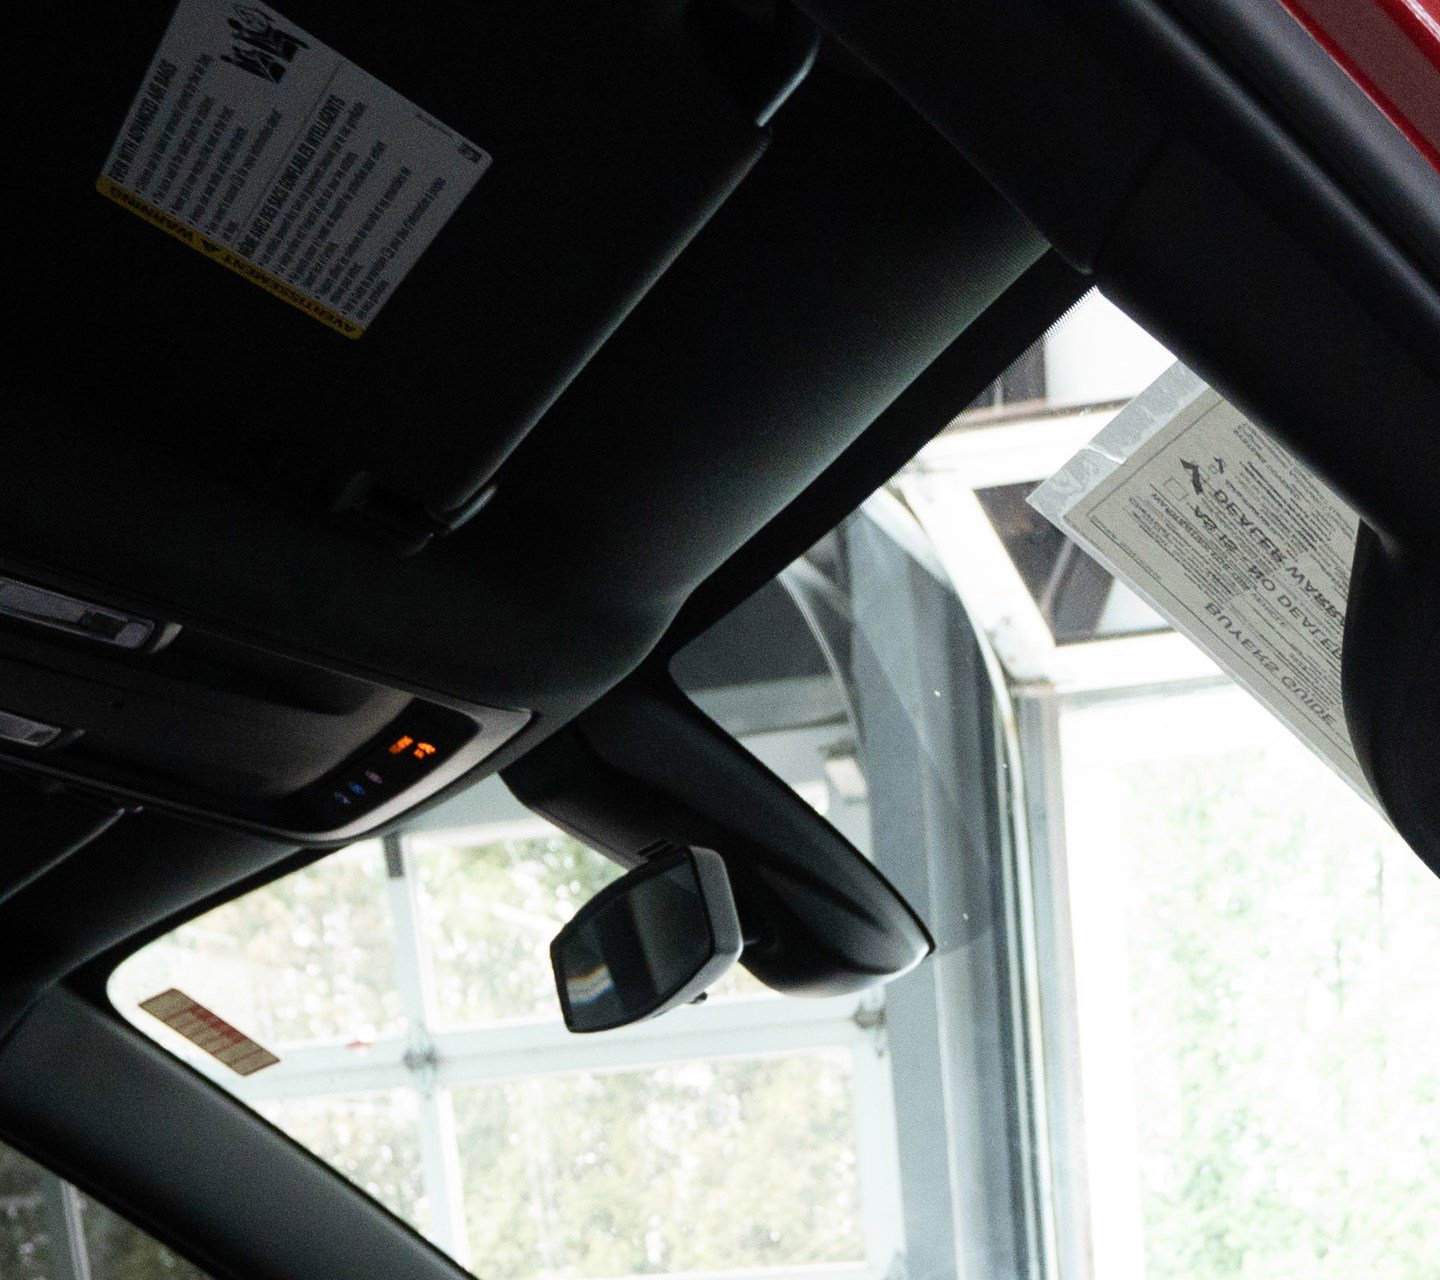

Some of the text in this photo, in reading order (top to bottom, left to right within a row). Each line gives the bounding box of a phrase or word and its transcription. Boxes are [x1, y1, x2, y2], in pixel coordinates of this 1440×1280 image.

[125, 96, 159, 145] ADVANCED
[303, 92, 346, 149] INTELLIGENTS
[116, 137, 139, 164] WITH
[266, 185, 289, 209] SACS
[257, 203, 279, 223] DES
[247, 216, 270, 240] AVEC
